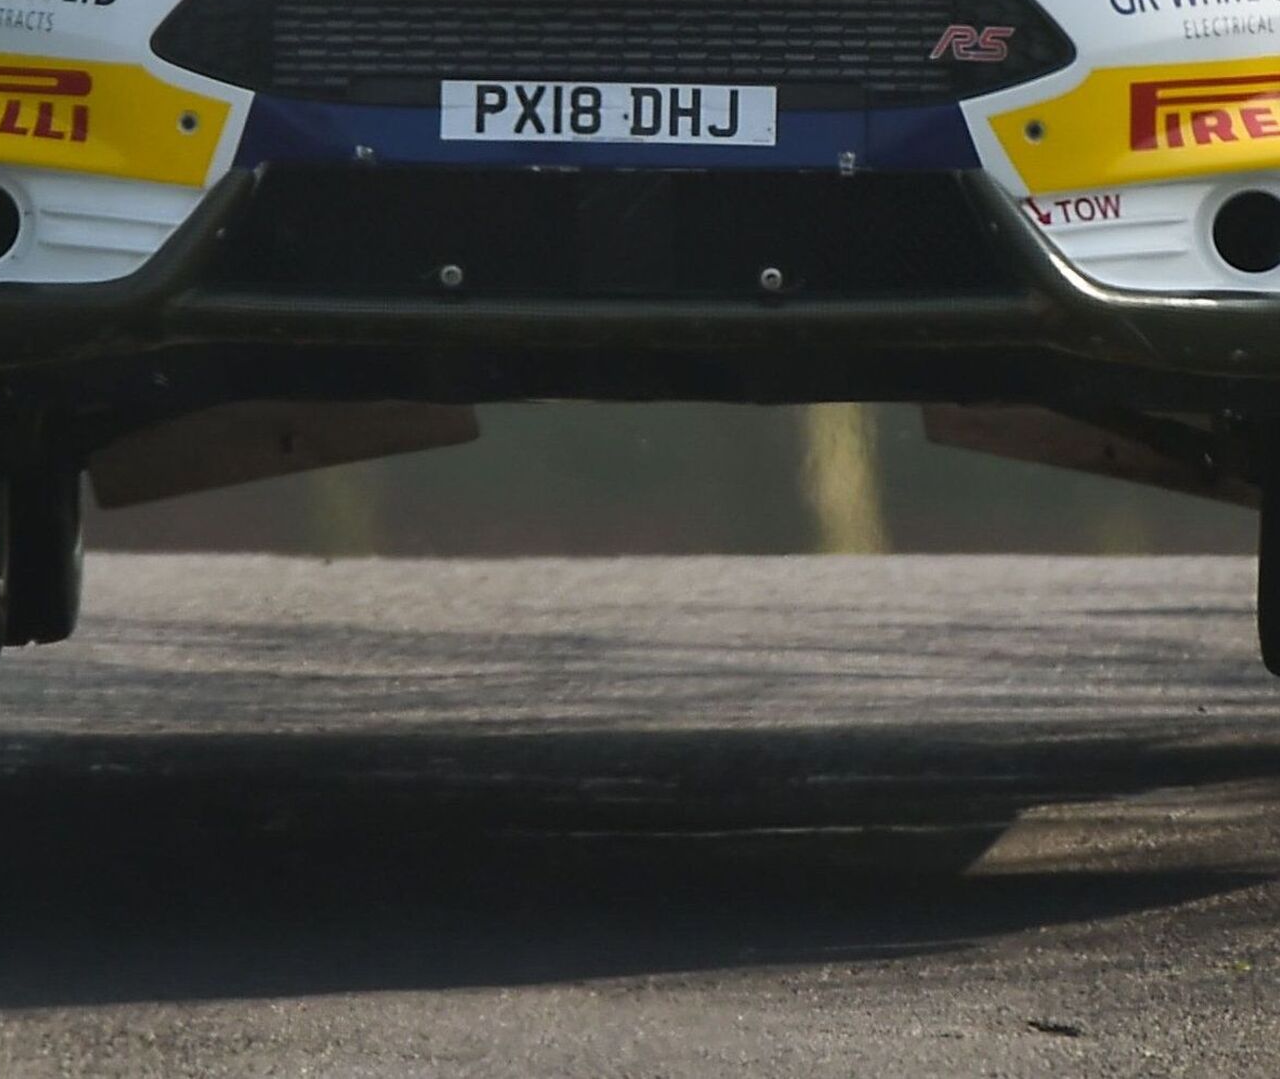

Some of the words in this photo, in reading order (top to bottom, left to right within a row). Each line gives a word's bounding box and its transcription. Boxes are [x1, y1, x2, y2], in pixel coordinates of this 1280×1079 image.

[929, 24, 1016, 62] RS
[1182, 14, 1276, 40] ELECTRICAL
[475, 84, 603, 135] PX18
[629, 87, 740, 138] DHJ
[1054, 194, 1120, 223] TOW
